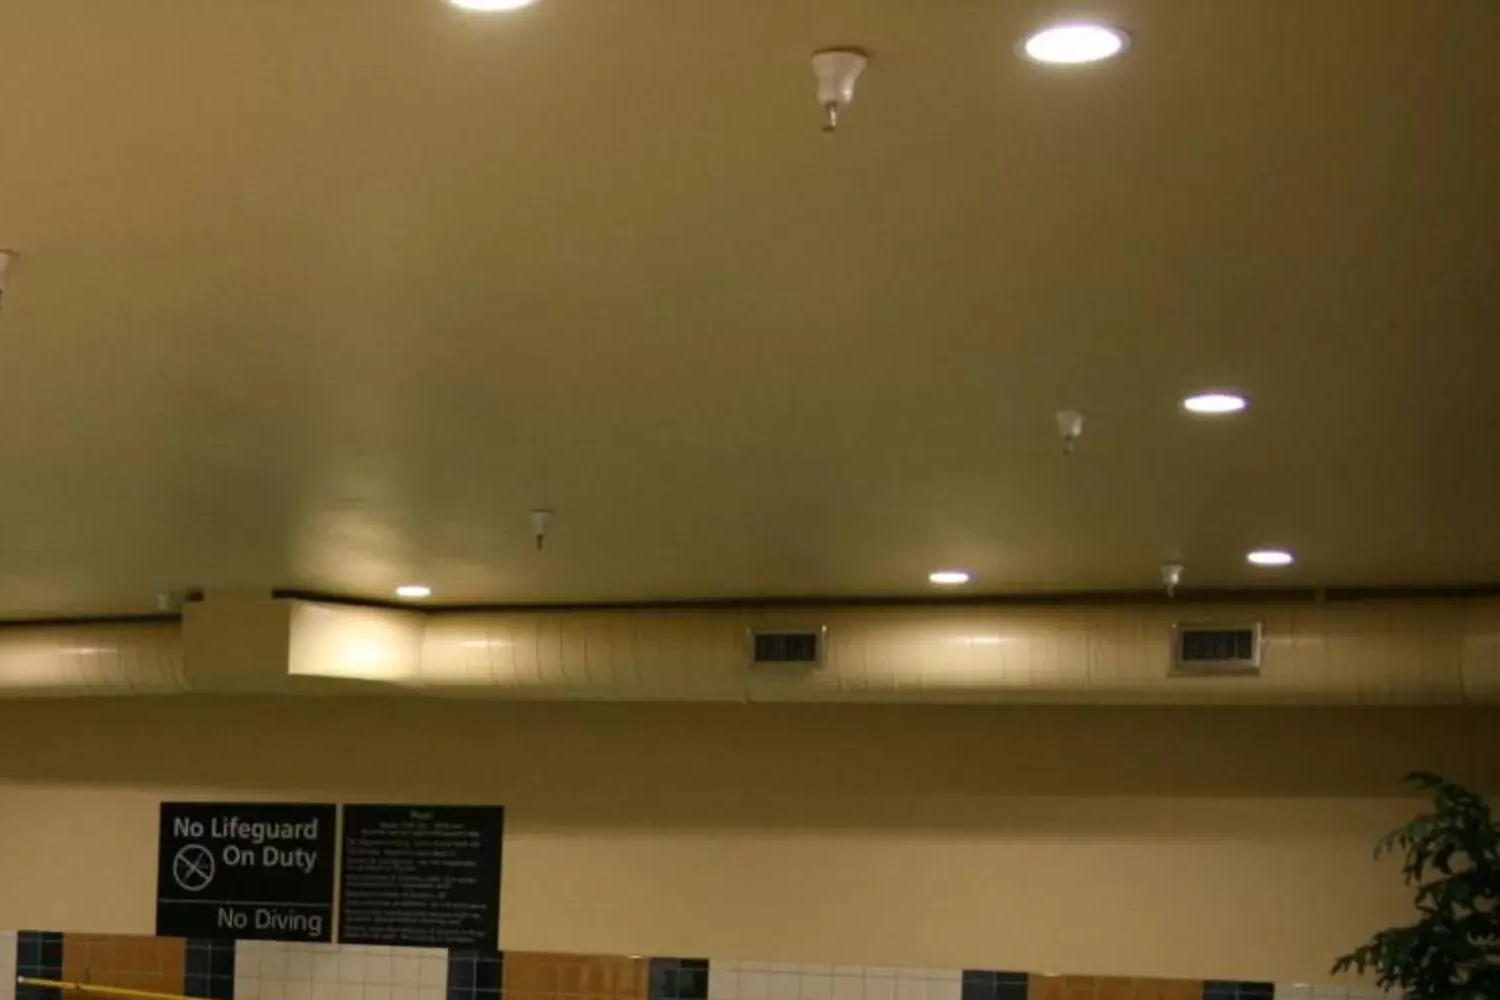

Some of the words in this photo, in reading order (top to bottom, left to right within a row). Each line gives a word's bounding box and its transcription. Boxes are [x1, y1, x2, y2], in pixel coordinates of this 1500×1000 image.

[173, 816, 204, 838] No
[210, 816, 320, 844] Lifeguard
[222, 844, 255, 866] On
[262, 845, 317, 875] Duty
[217, 906, 248, 929] No
[255, 908, 323, 937] Diving
